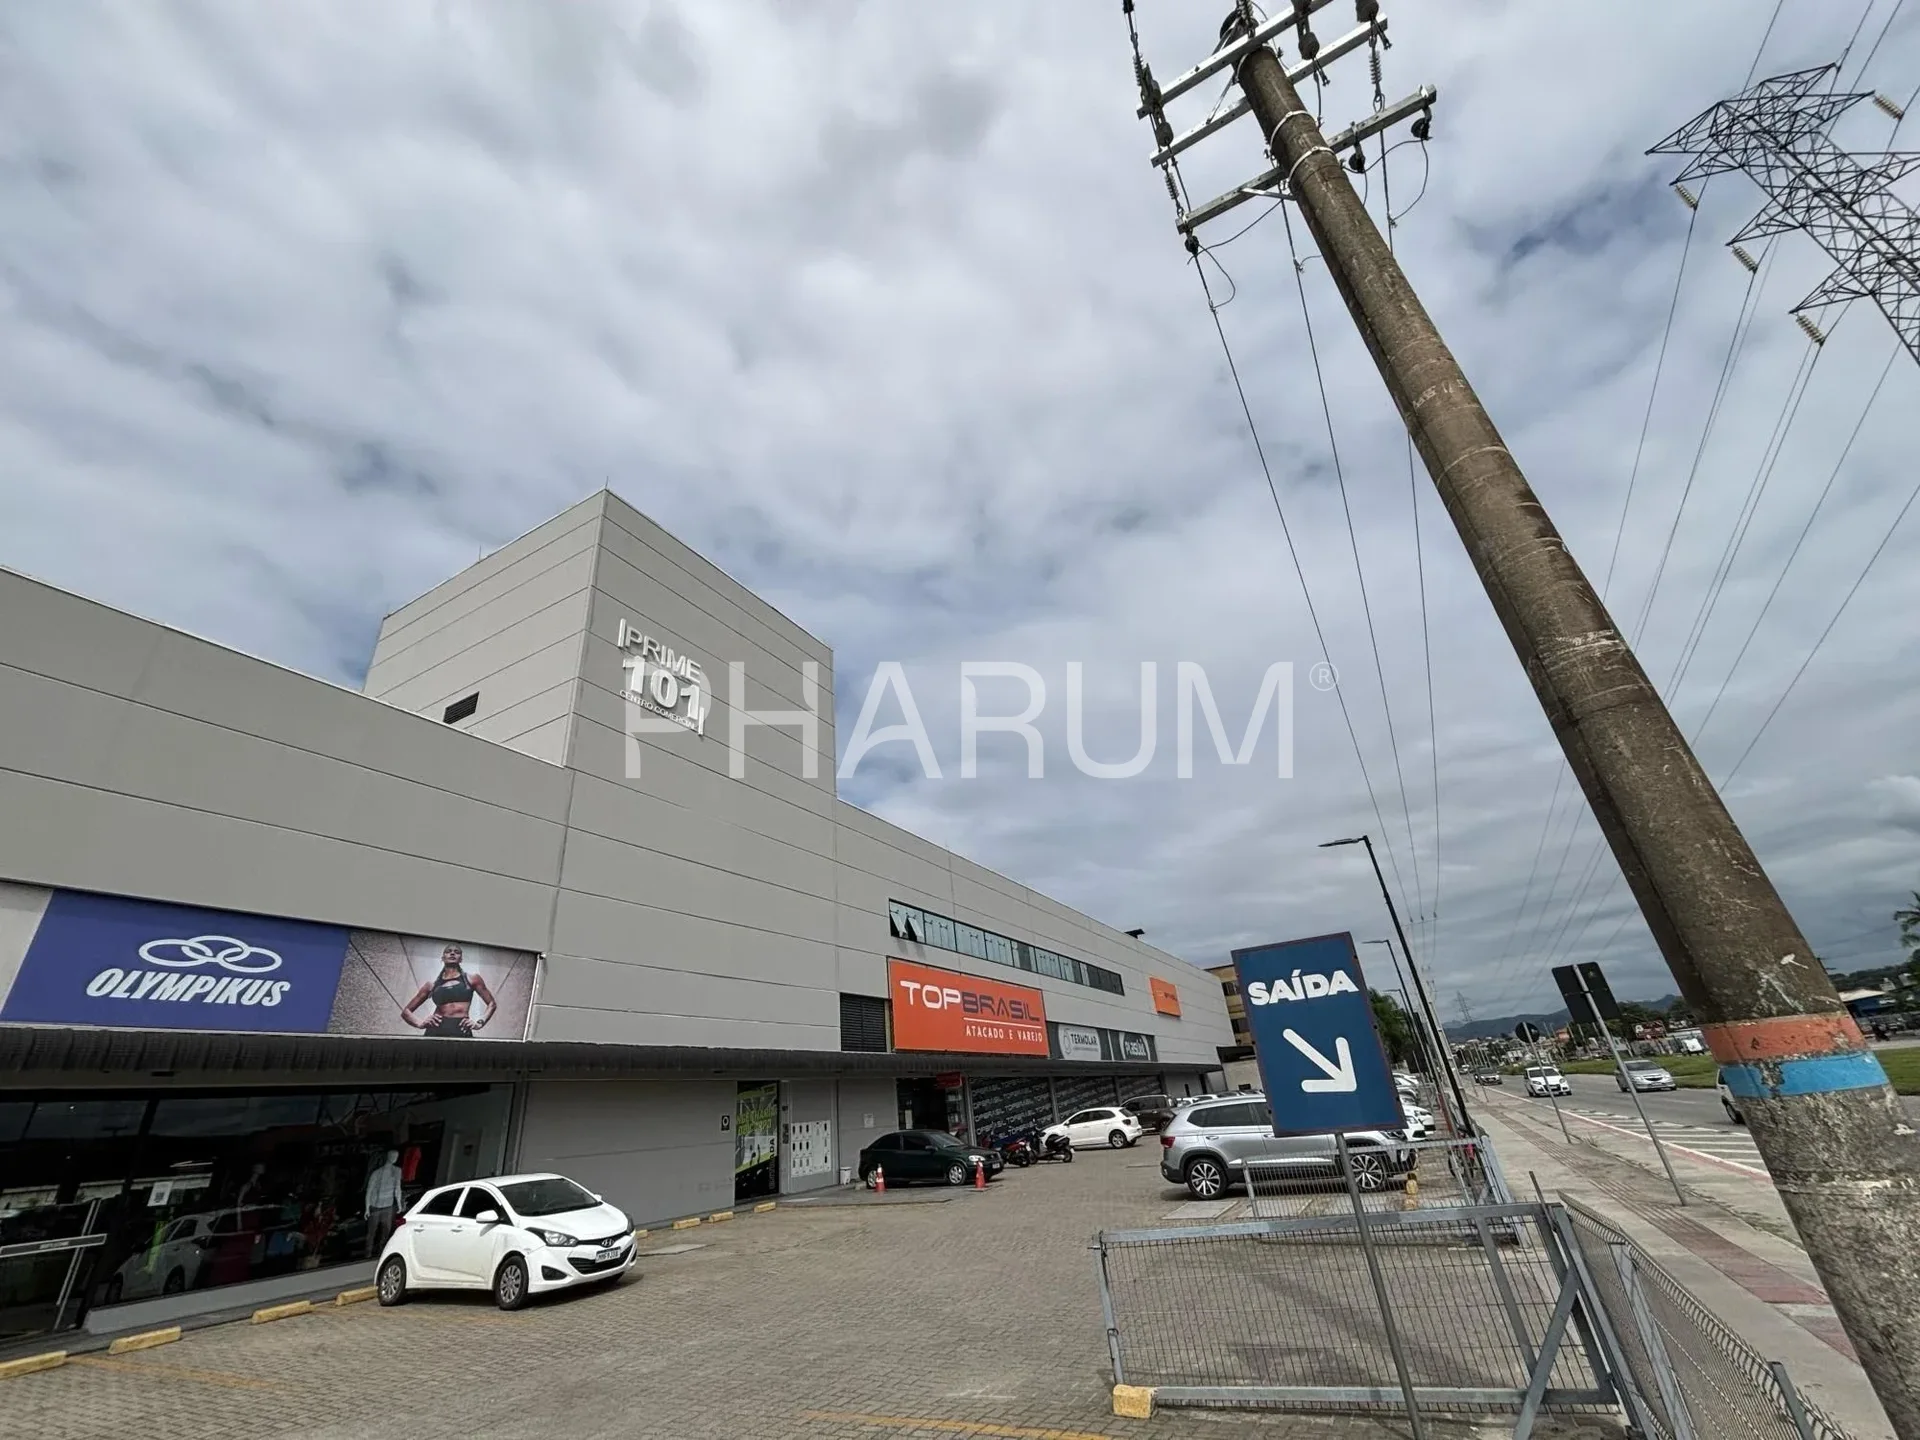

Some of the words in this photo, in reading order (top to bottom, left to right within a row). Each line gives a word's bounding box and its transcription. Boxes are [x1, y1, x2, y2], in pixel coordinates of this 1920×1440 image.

[625, 626, 701, 684] PRIME
[620, 689, 654, 711] CENTRO
[622, 655, 700, 720] 101
[86, 968, 291, 1007] OLYMPIKUS
[900, 980, 1040, 1022] TOPBRASIL
[1247, 969, 1360, 1006] SAÍDA
[965, 1025, 1004, 1039] ATACADO
[1009, 1029, 1014, 1040] E
[1017, 1030, 1043, 1042] VAREJO
[1070, 1033, 1098, 1046] TERMOLAR
